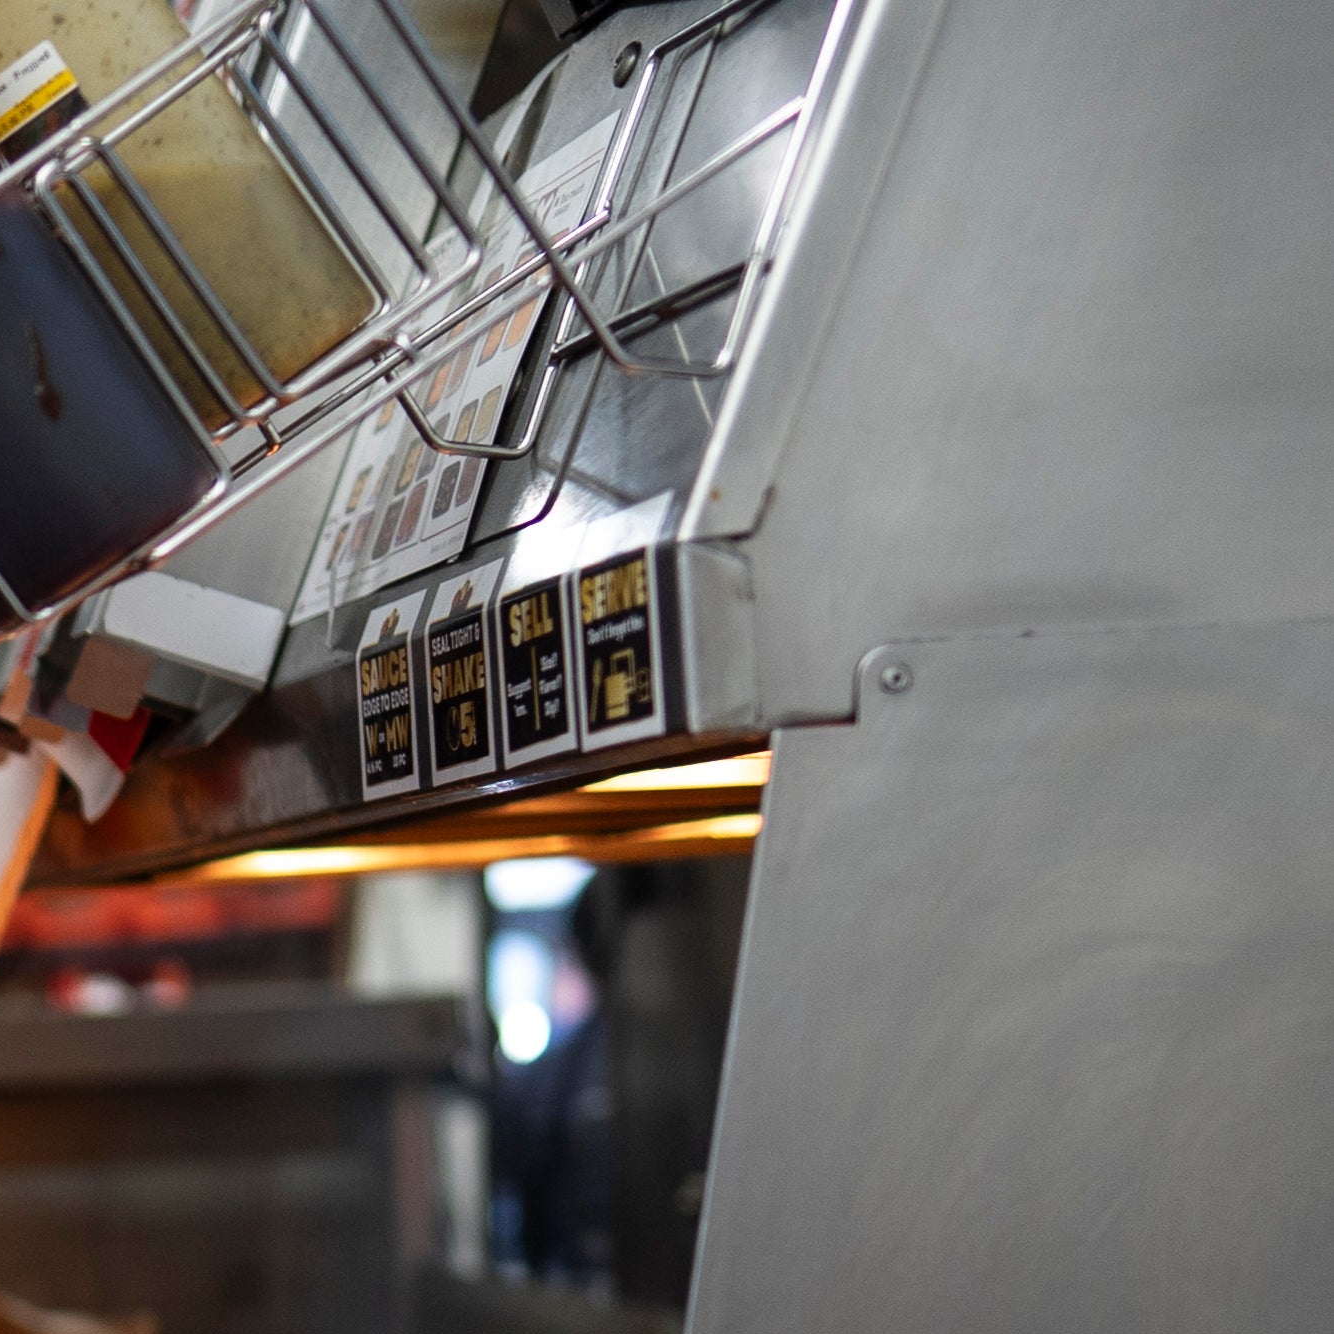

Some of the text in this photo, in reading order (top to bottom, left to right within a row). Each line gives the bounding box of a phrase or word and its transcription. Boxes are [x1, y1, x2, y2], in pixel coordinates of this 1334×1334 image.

[581, 560, 646, 624] SERVE
[431, 632, 450, 657] SEAL
[450, 625, 475, 651] TIGHT
[509, 591, 553, 647] SELL
[361, 647, 408, 697] SAUCE
[433, 652, 485, 704] SHAKE
[363, 687, 409, 718] EDGE TO EDGE
[365, 723, 379, 757] W
[385, 713, 409, 752] MW
